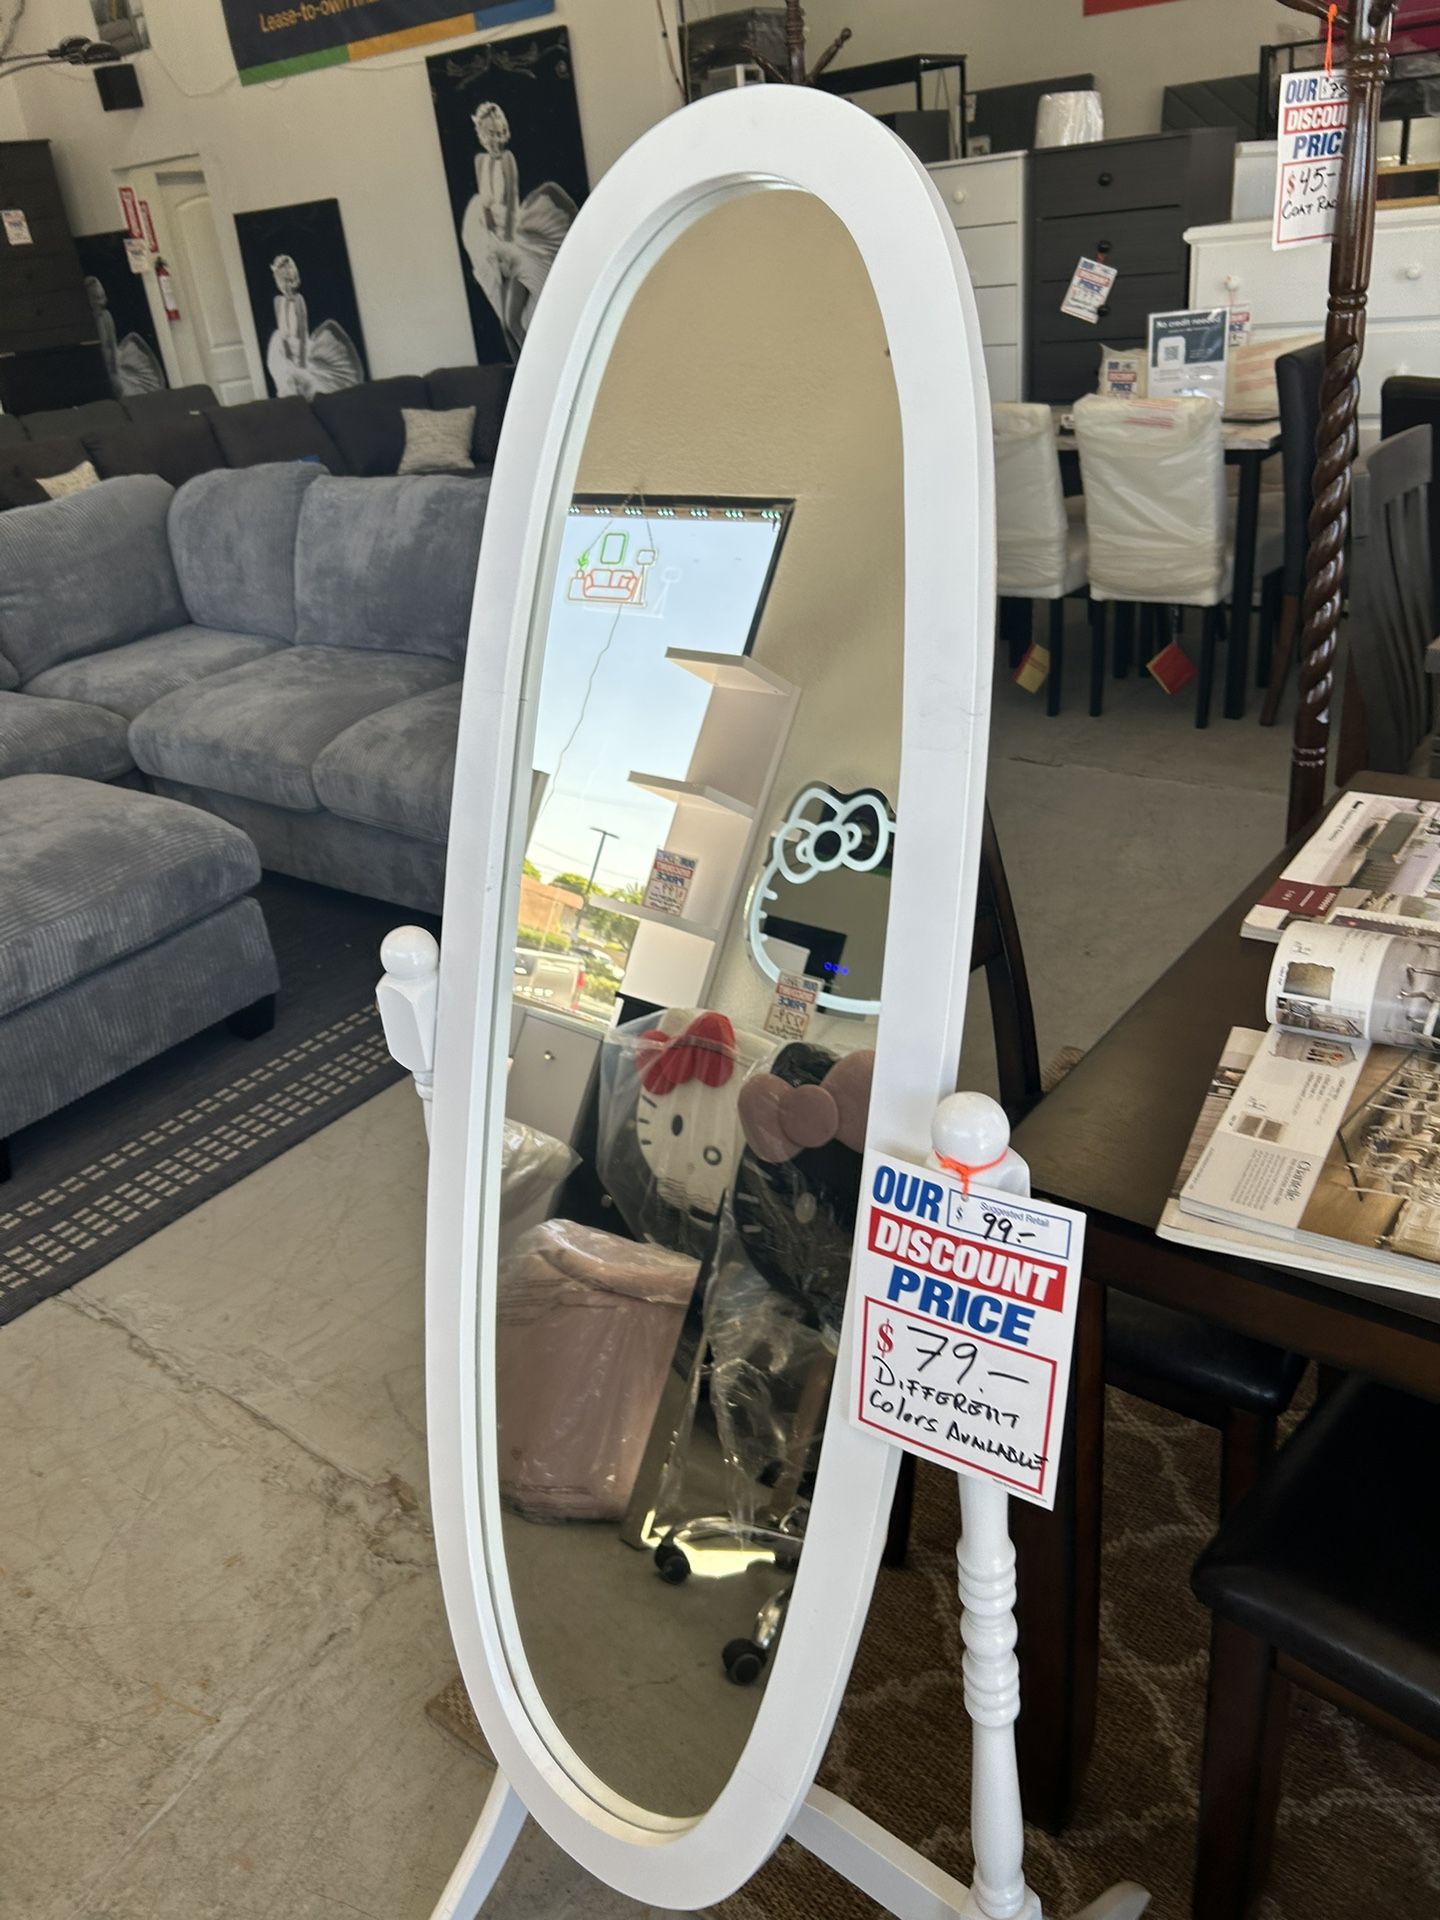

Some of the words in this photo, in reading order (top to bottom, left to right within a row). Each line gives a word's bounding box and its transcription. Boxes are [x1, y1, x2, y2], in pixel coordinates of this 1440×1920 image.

[1286, 79, 1317, 104] OUR
[1287, 104, 1348, 131] DISCOU
[1293, 131, 1343, 159] PRIC
[872, 1165, 944, 1223] OUR
[955, 1206, 964, 1222] $
[980, 1201, 1024, 1221] Suggested
[1025, 1213, 1050, 1227] Retail
[874, 1215, 1059, 1301] DISCOUNT
[887, 1264, 1036, 1346] PRICE
[946, 1421, 1049, 1471] AVAILABLE
